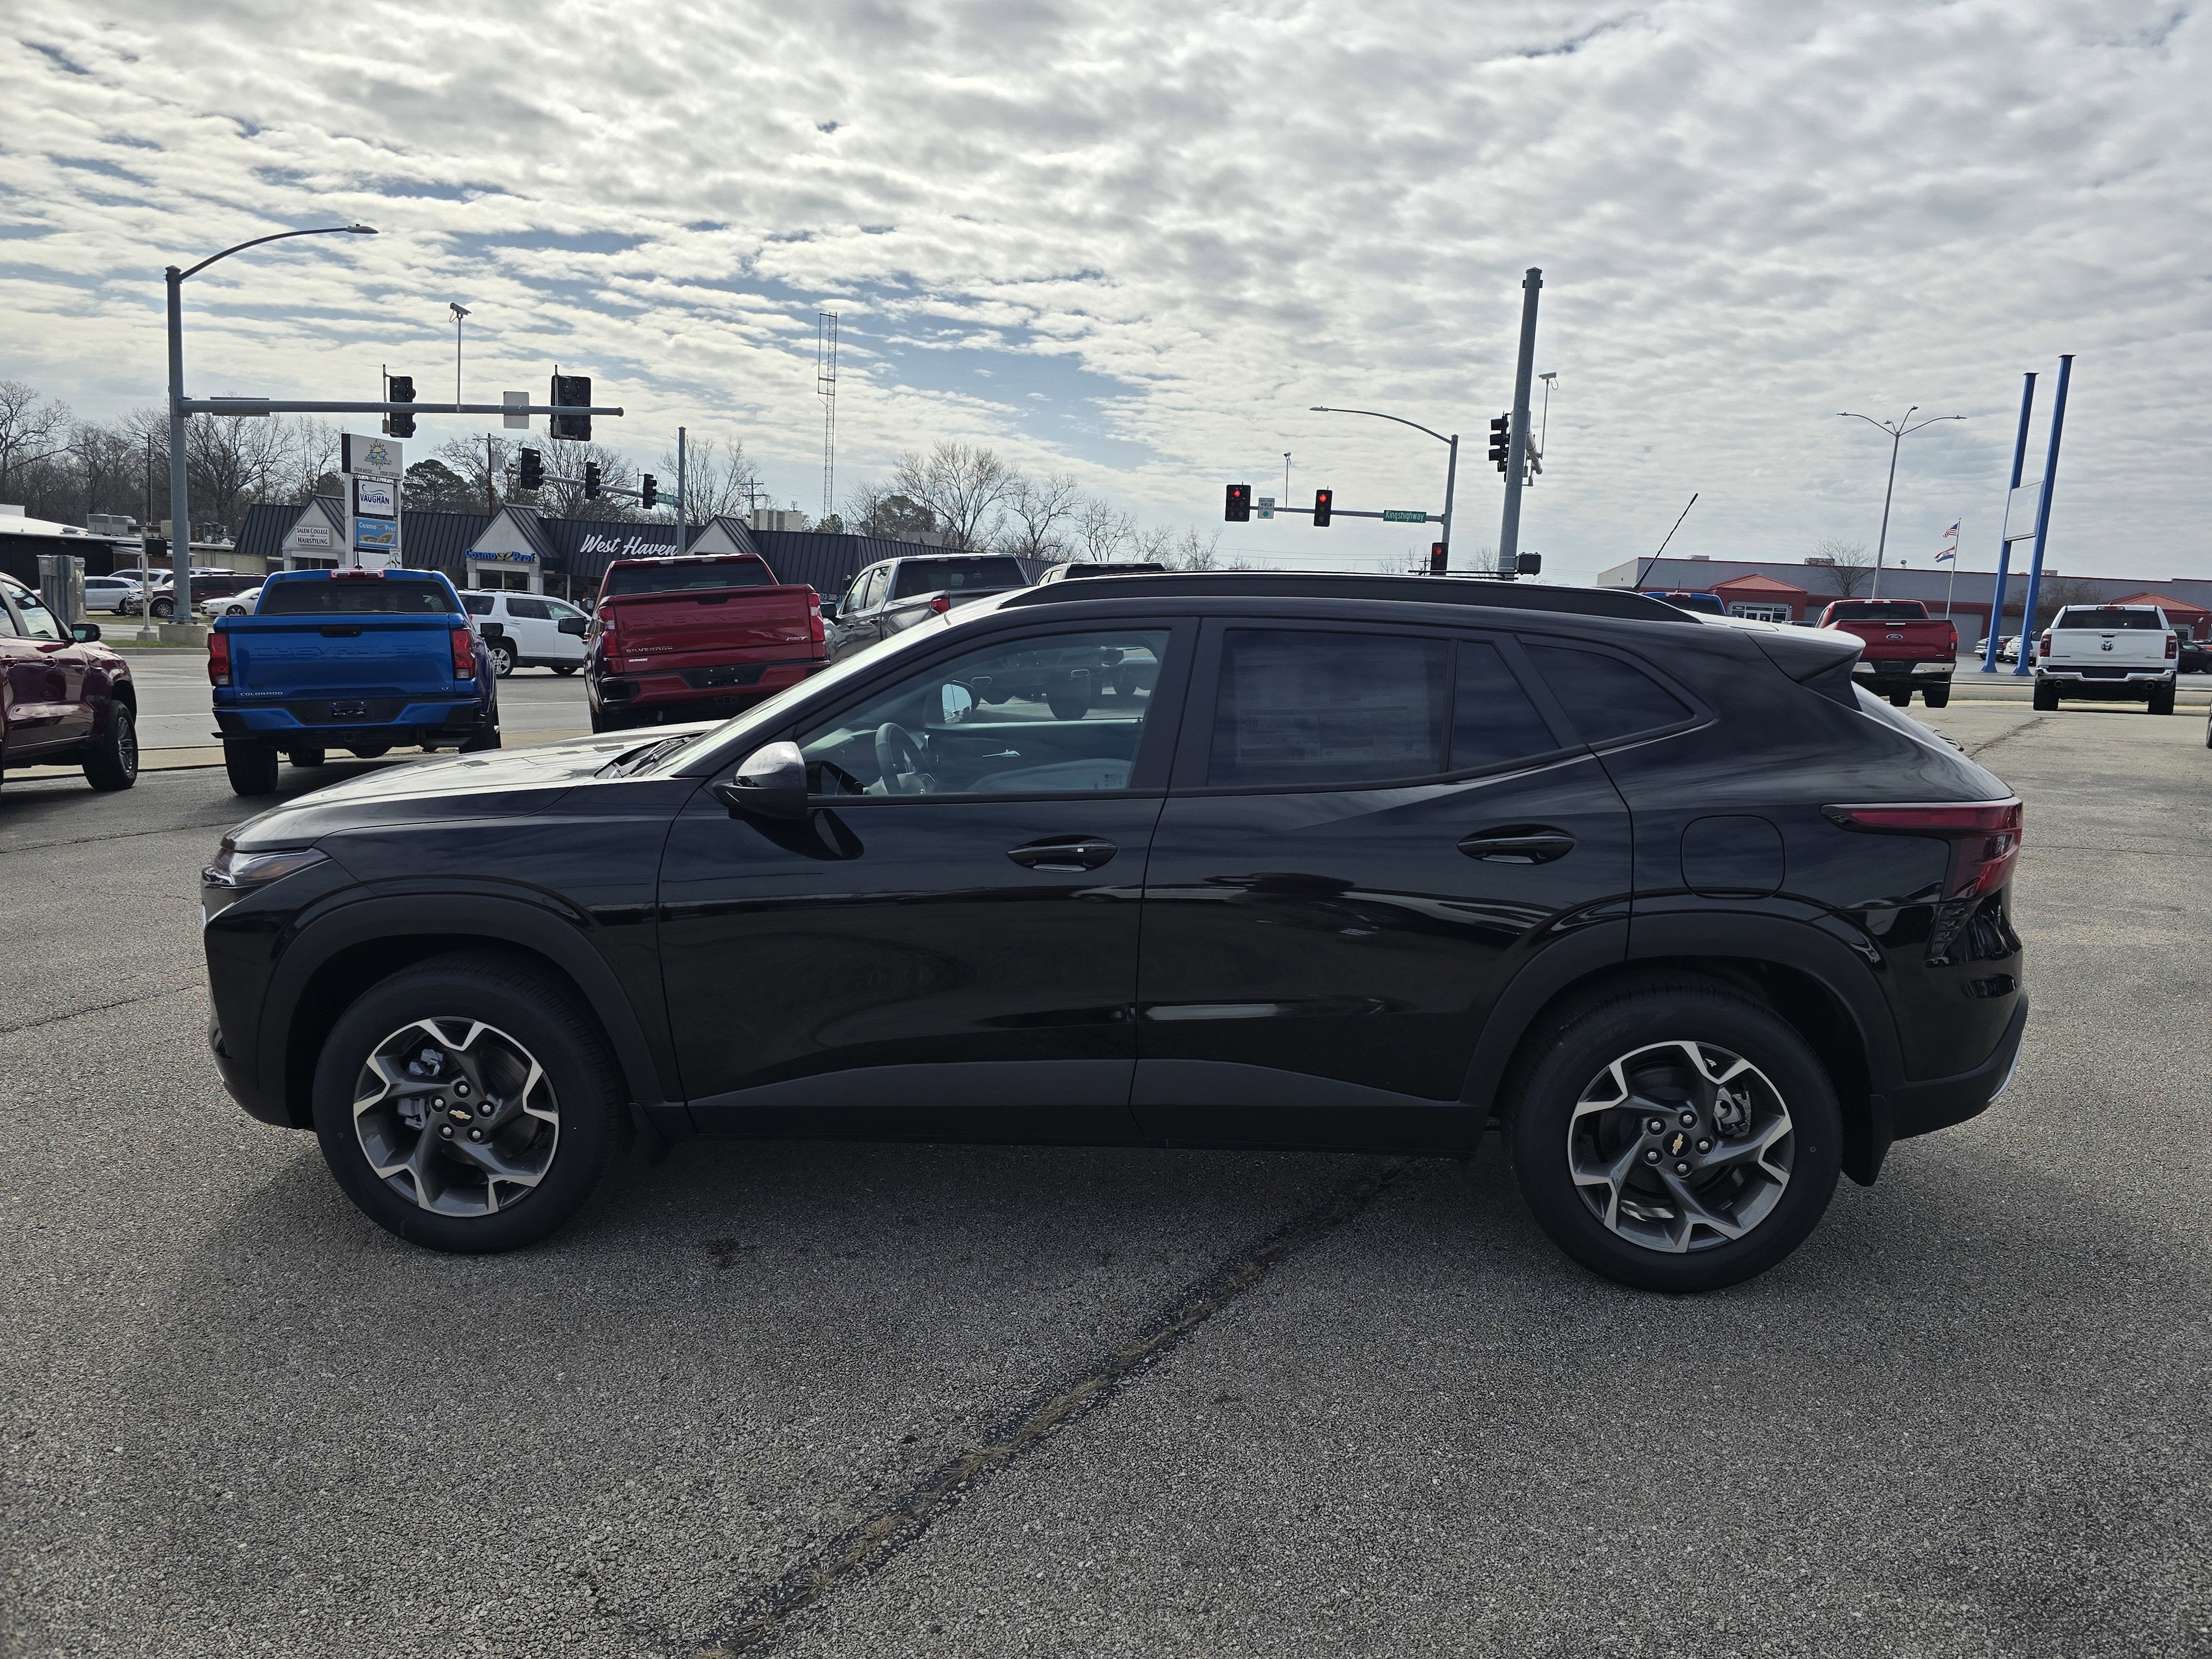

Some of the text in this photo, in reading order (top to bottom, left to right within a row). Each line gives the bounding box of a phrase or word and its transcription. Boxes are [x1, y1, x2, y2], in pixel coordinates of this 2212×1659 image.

[360, 493, 389, 505] VAUGHAN
[1385, 510, 1425, 522] Kingshighway
[359, 521, 377, 530] Cosmo
[580, 534, 678, 556] West Haven
[465, 548, 535, 562] Cosmo Prof
[253, 645, 429, 658] CHEVROLET
